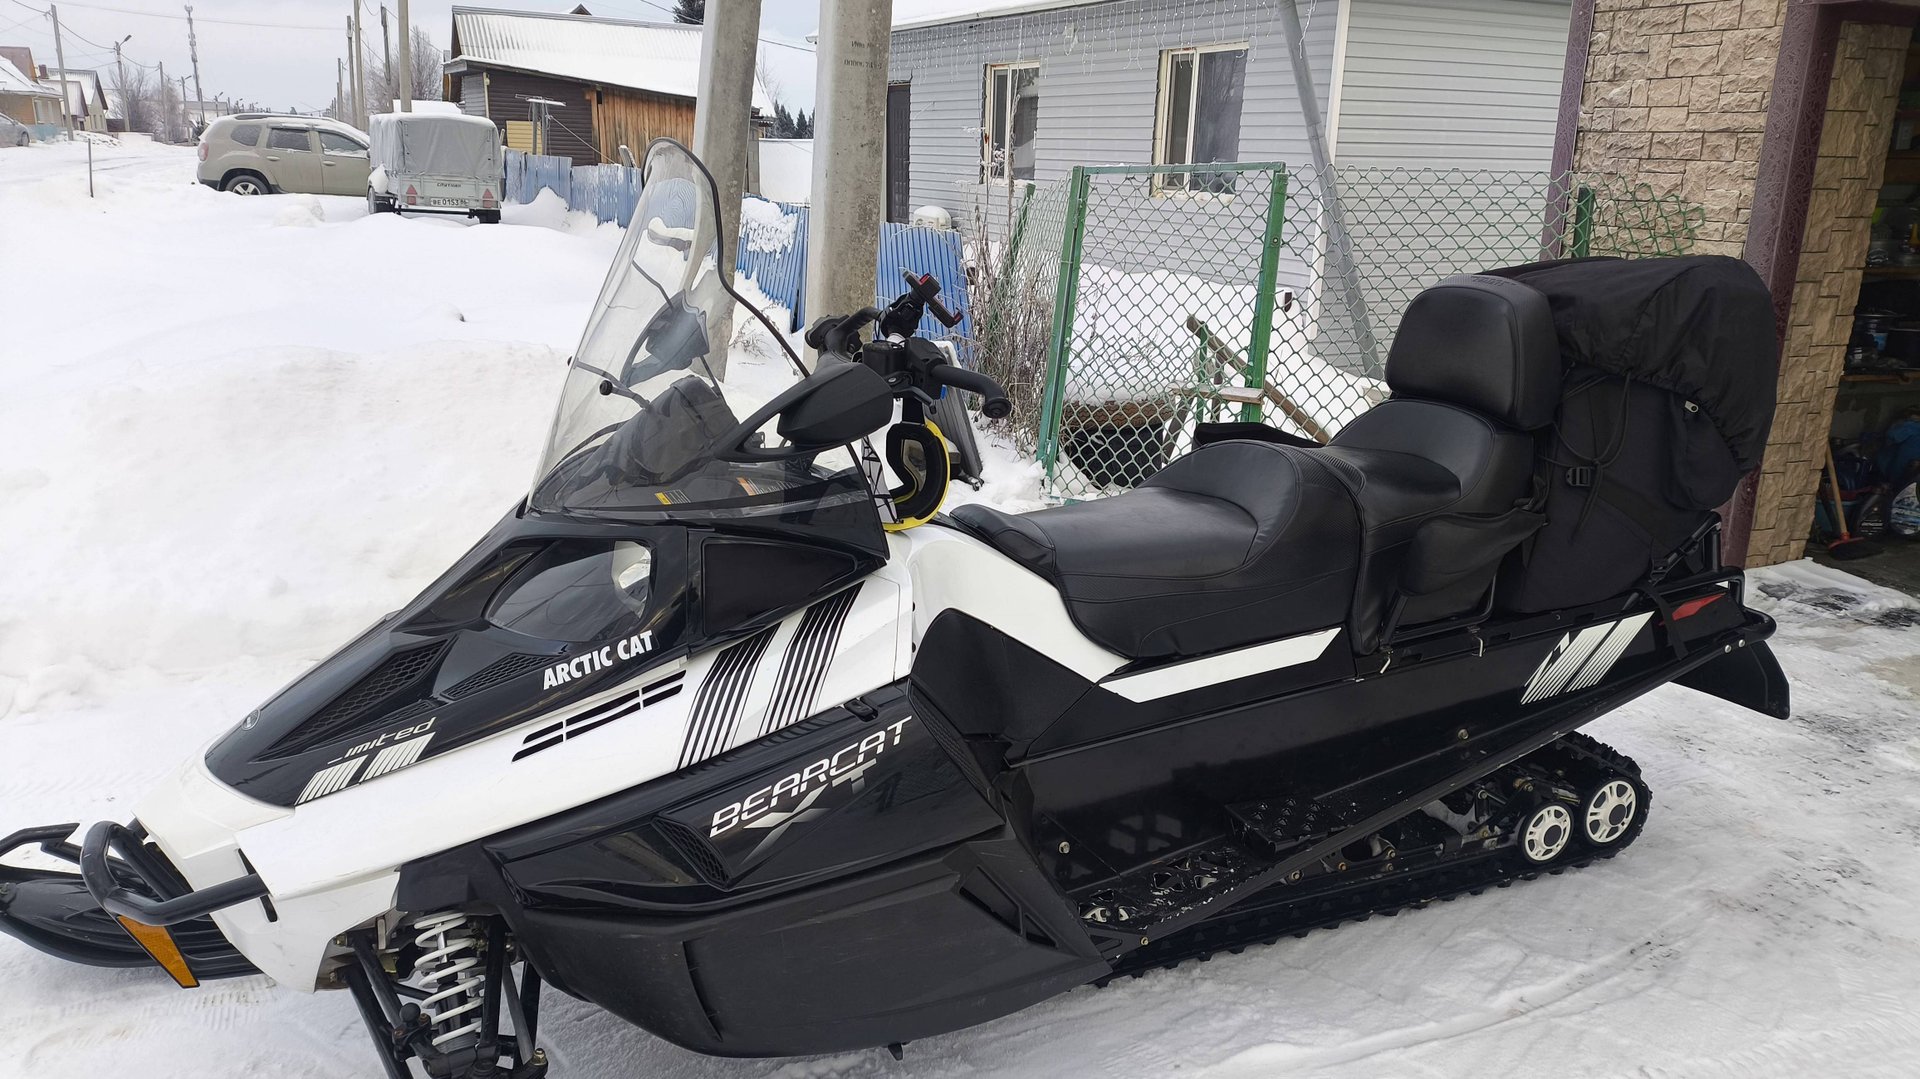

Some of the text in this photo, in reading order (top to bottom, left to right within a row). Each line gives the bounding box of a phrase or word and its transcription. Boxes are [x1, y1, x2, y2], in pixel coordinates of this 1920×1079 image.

[543, 629, 653, 690] ARCTIC CAT
[709, 715, 912, 838] BEARCAT
